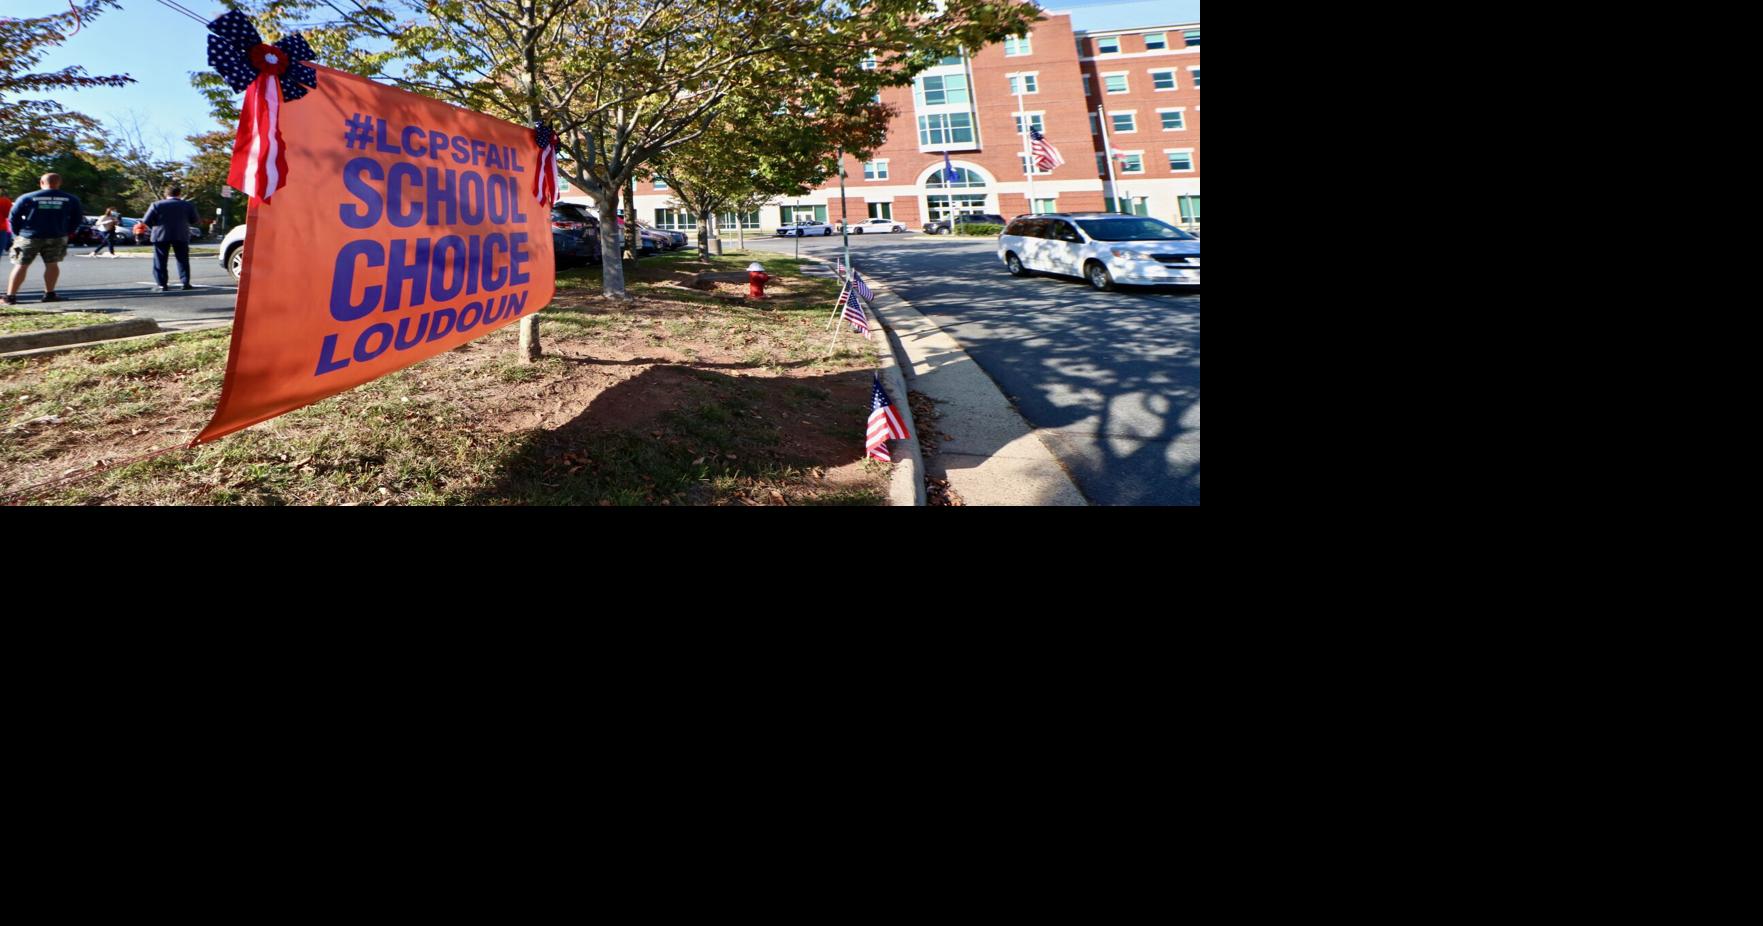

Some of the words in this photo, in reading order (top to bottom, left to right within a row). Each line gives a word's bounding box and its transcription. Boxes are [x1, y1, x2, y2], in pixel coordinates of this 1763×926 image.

[344, 113, 524, 172] #LCPSFAIL
[339, 157, 527, 229] SCHOOL
[330, 232, 529, 321] CHOICE
[314, 291, 528, 376] LOUDOUN
